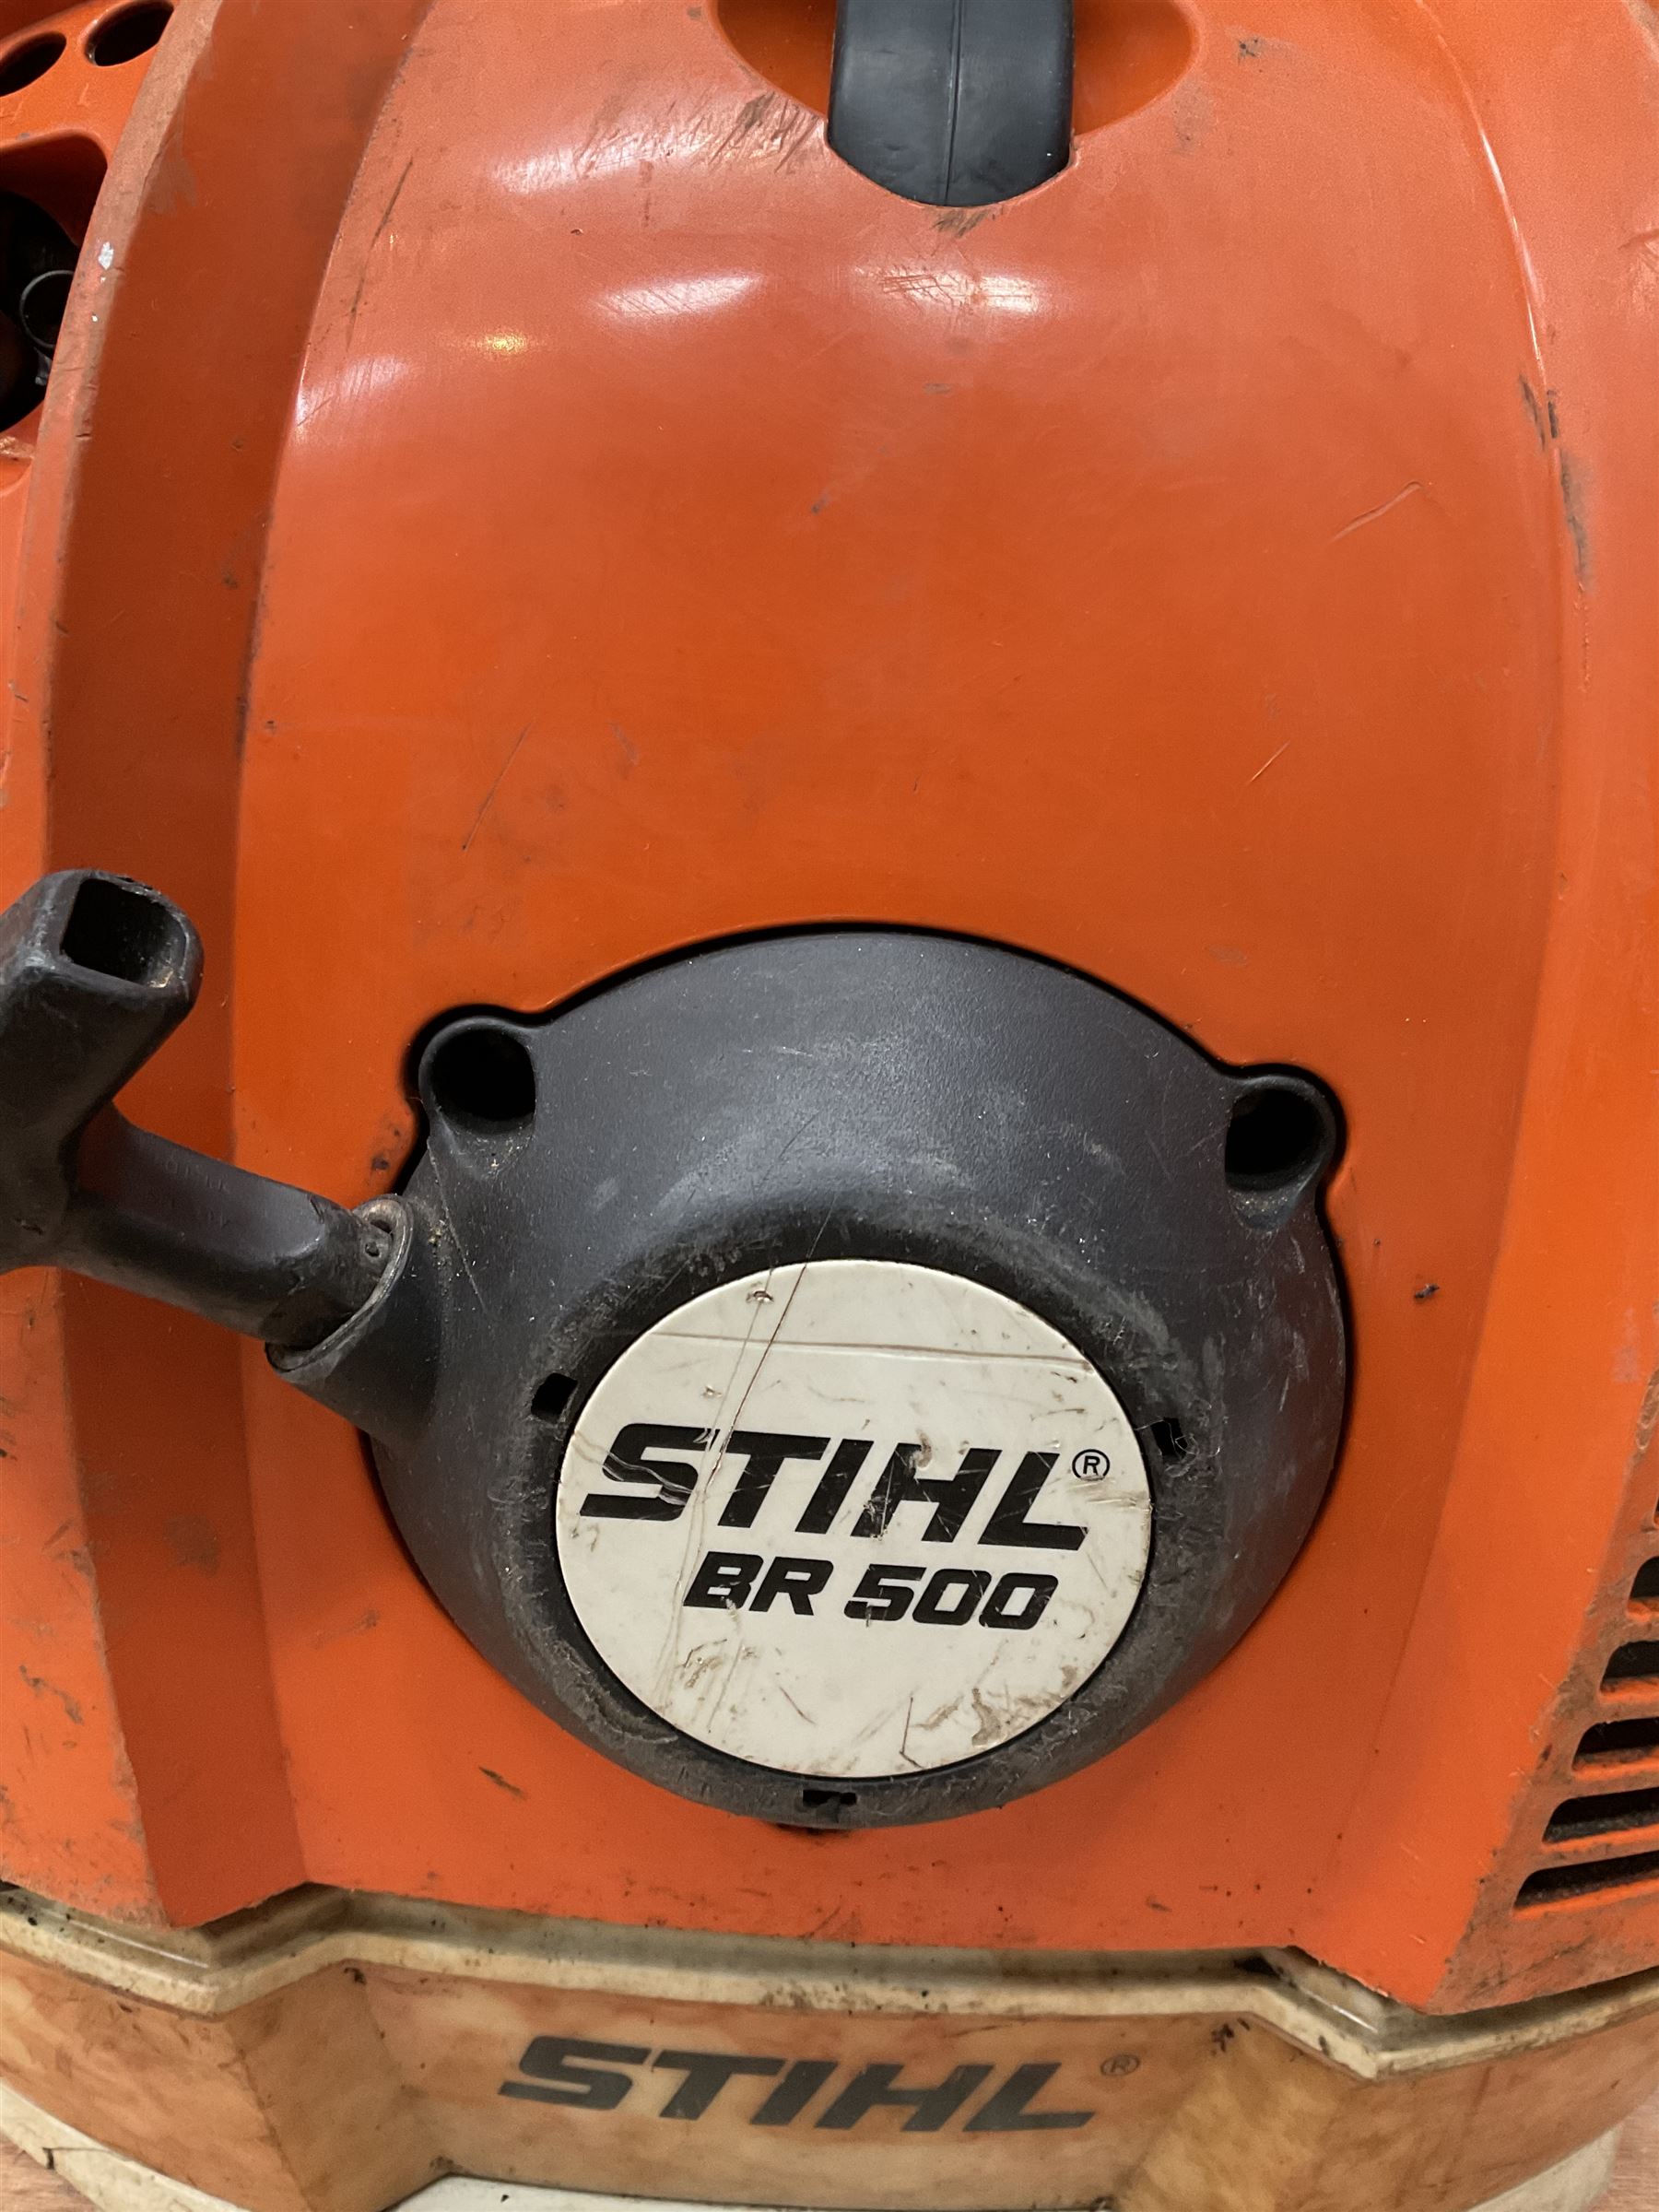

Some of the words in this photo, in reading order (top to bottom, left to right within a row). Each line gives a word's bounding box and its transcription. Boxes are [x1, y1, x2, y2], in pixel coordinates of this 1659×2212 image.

[580, 1423, 1088, 1551] STIHL
[683, 1551, 834, 1616] BR
[843, 1564, 1059, 1630] 500
[498, 2036, 1096, 2133] STIHL
